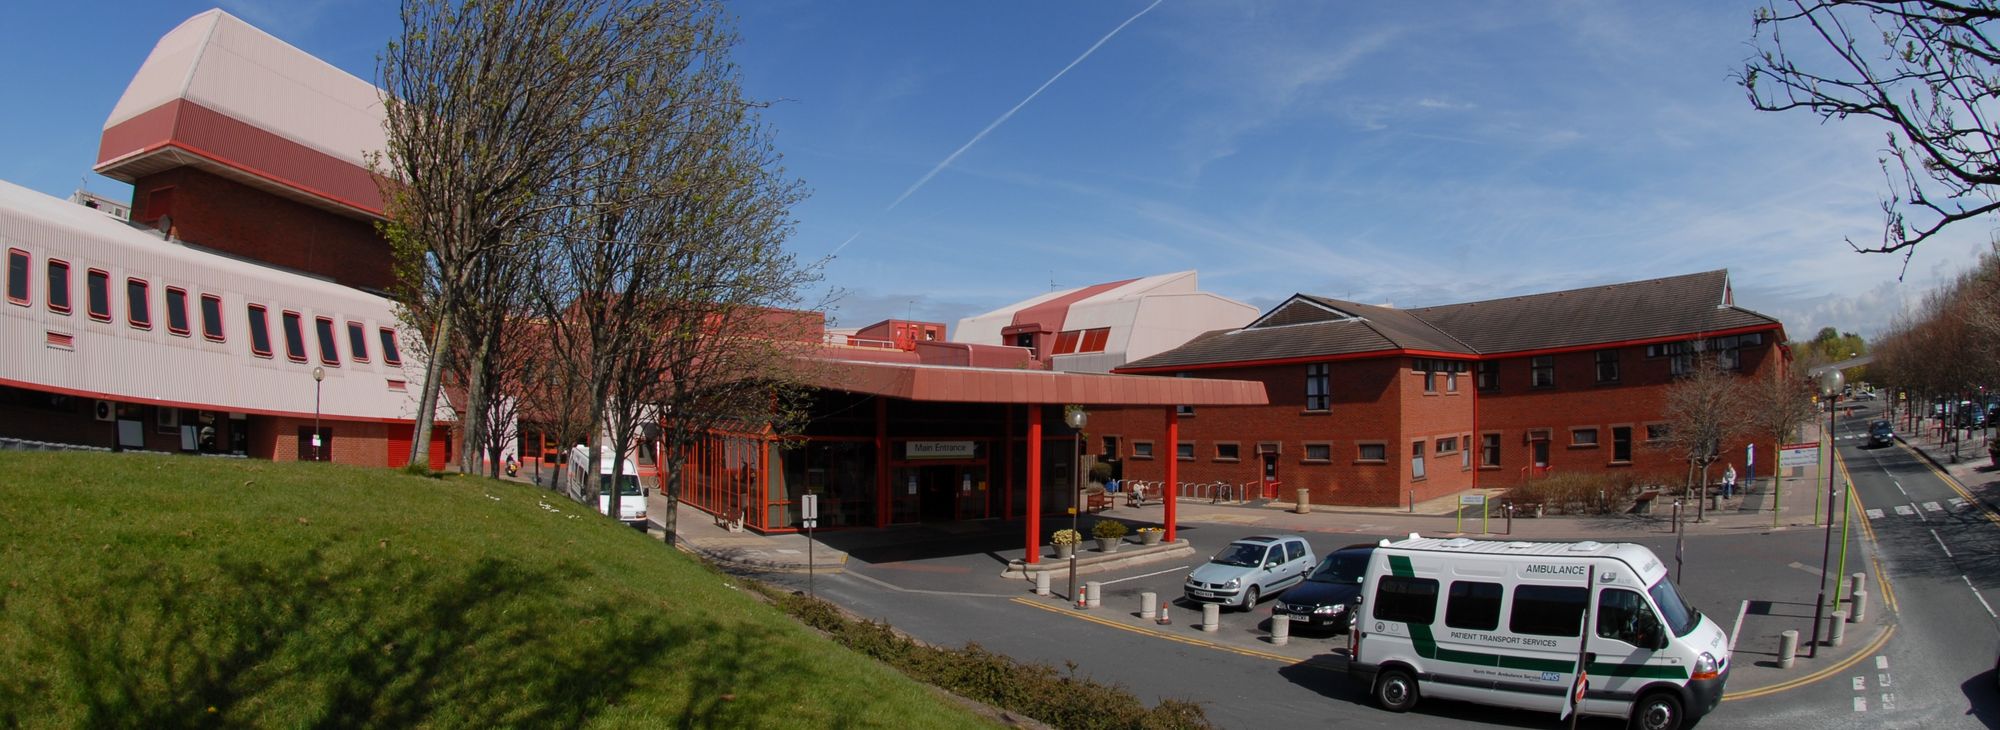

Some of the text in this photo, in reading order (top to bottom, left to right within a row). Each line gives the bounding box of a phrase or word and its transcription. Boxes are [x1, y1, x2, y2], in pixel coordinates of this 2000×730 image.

[914, 443, 966, 452] Main Entrance
[1526, 564, 1585, 575] AMBULANCE
[1450, 631, 1557, 647] PATIENT TRANSPORT SERVICES
[1542, 672, 1559, 681] NHS
